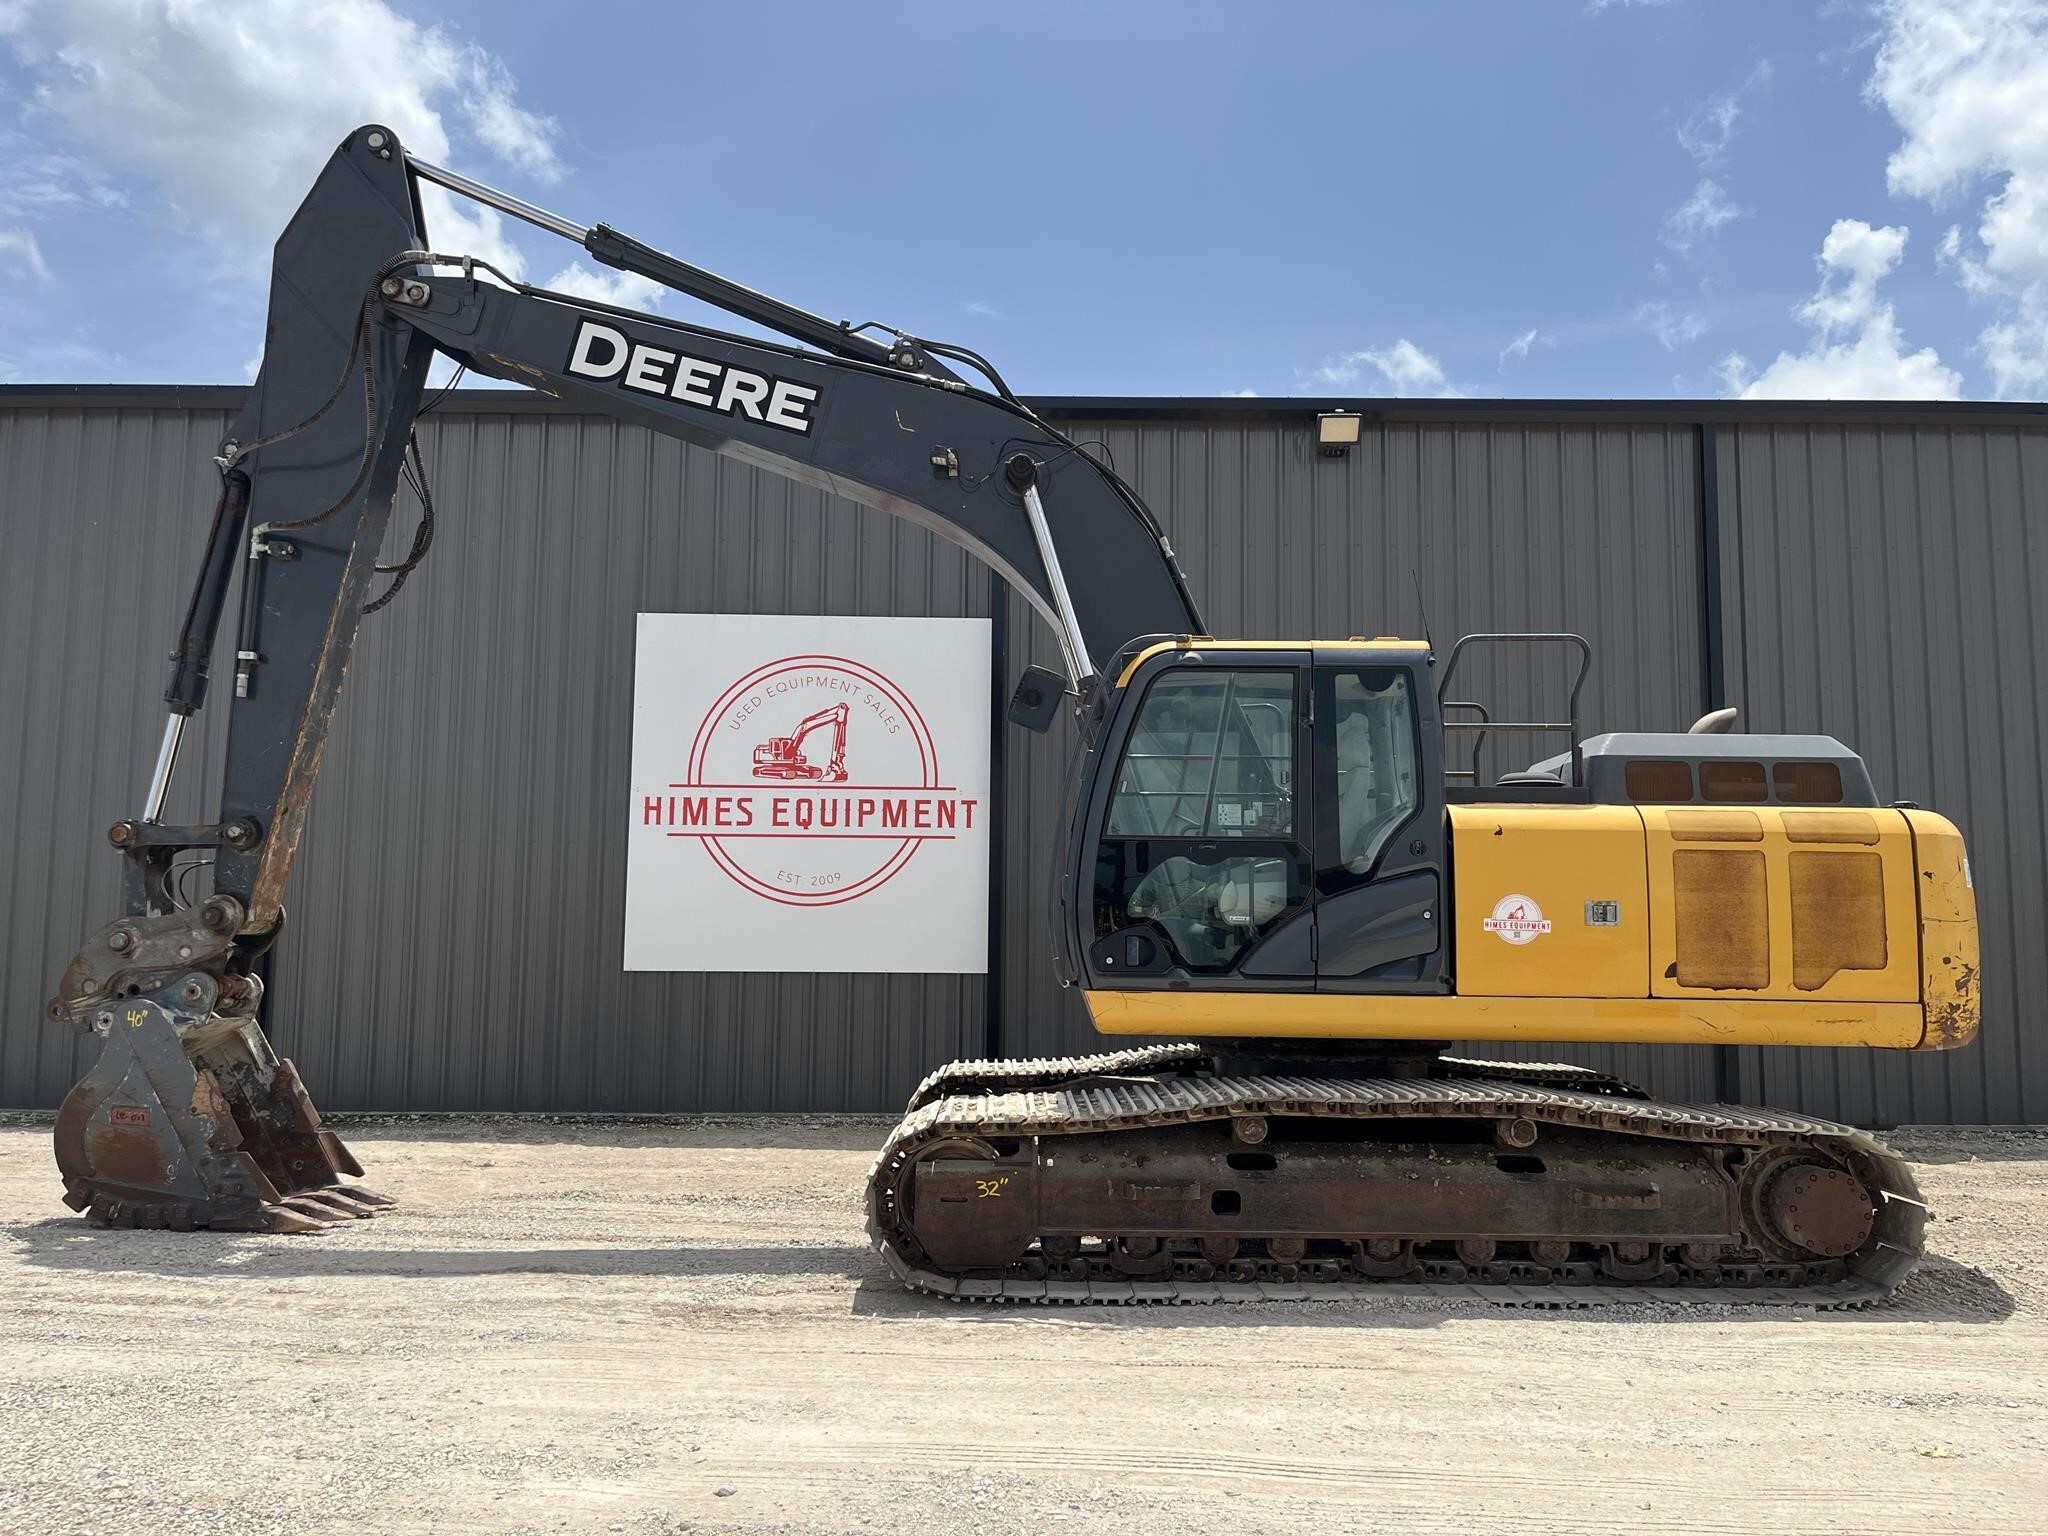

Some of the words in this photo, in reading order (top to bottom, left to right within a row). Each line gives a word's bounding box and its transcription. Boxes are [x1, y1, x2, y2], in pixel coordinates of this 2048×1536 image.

[569, 321, 817, 432] DEERE
[729, 696, 762, 731] USED
[765, 676, 861, 698] EQUIPMENT
[863, 694, 900, 734] SALES
[643, 796, 754, 827] HIMES
[771, 797, 978, 830] EQUIPMENT
[811, 872, 842, 887] 2009
[1484, 921, 1507, 930] HIMES
[1509, 921, 1551, 931] EQUIPMENT
[127, 1009, 149, 1028] 40"
[975, 1177, 1009, 1198] 32"
